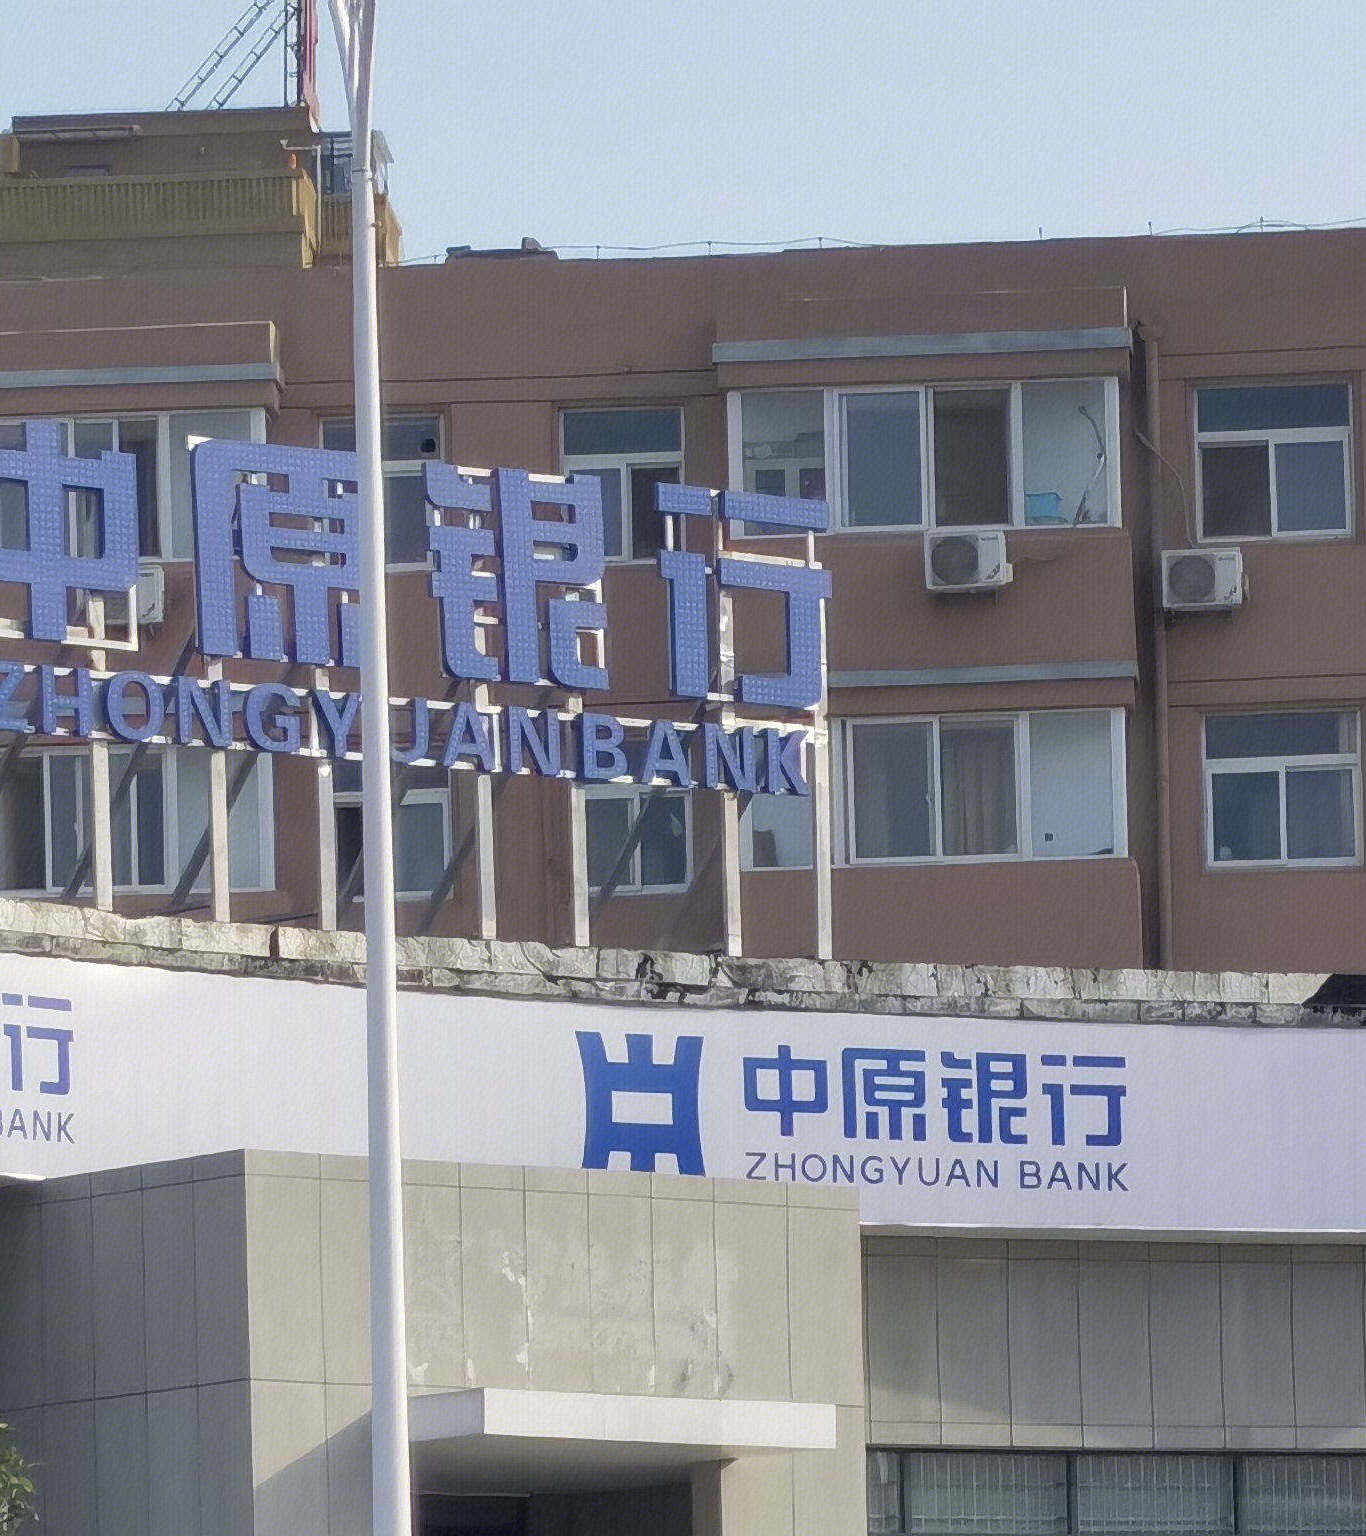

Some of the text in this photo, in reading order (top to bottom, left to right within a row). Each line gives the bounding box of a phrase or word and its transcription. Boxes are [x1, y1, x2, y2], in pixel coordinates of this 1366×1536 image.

[743, 1044, 1127, 1147] 中原银行
[745, 1151, 1130, 1192] ZHONGYUAN BANK
